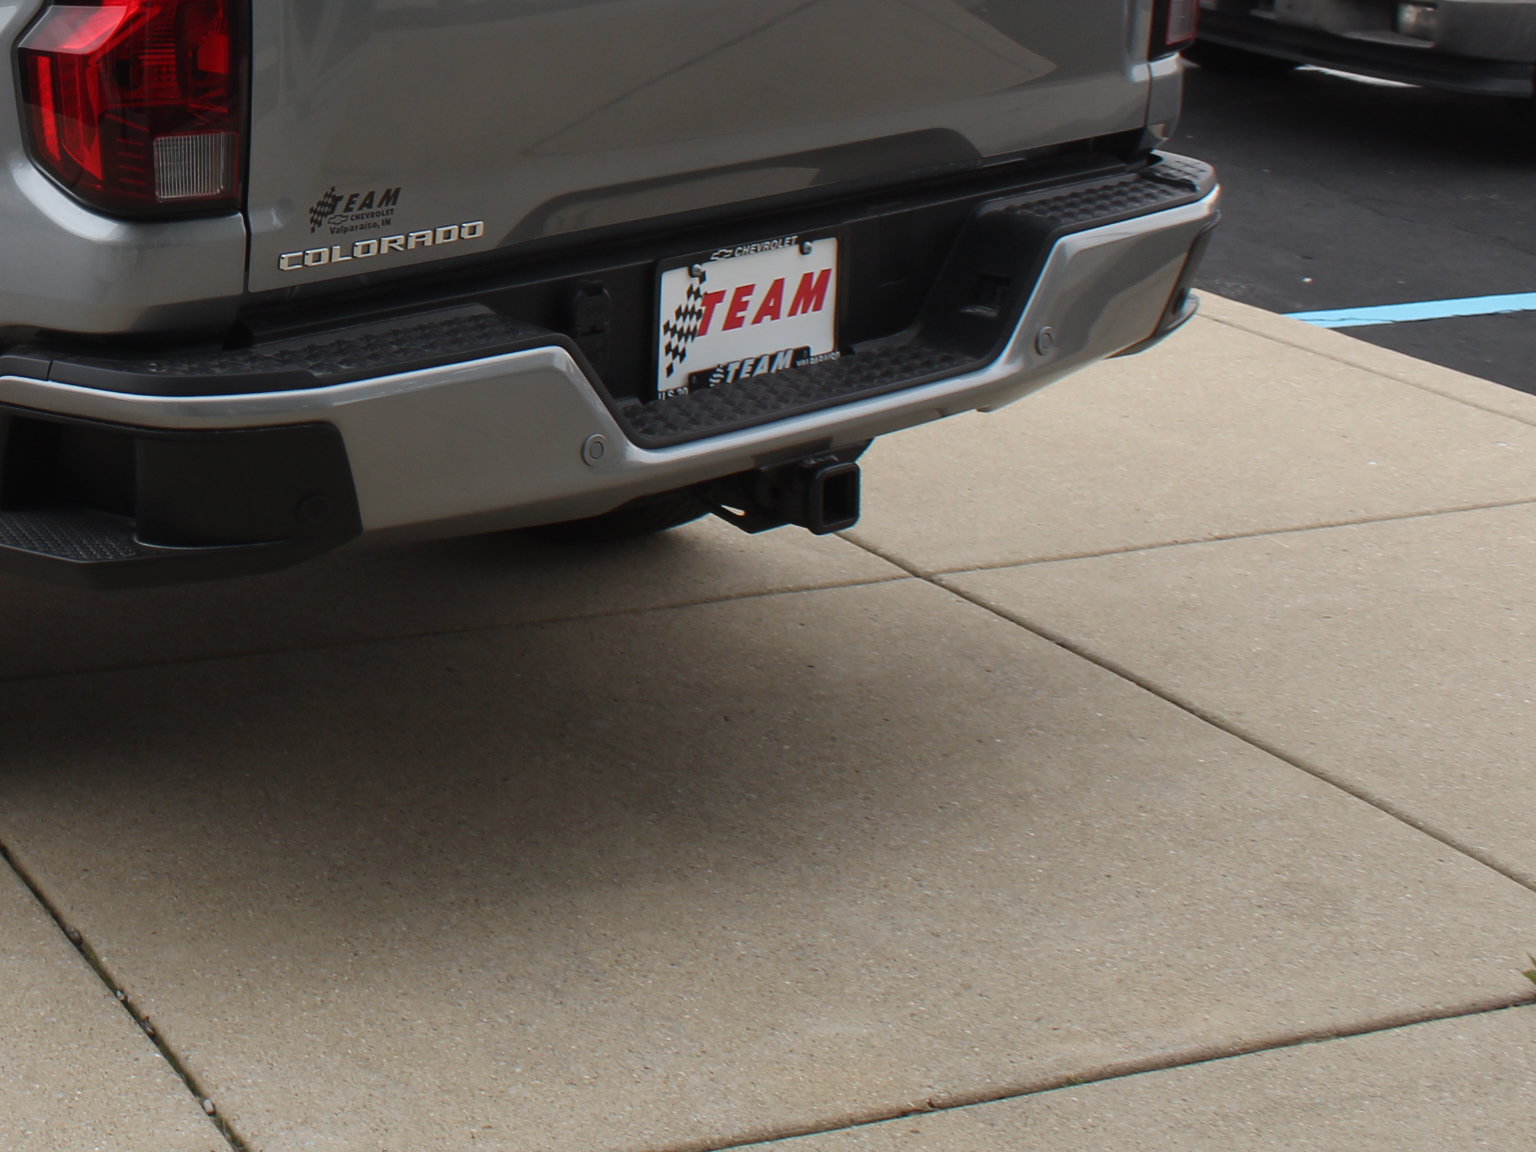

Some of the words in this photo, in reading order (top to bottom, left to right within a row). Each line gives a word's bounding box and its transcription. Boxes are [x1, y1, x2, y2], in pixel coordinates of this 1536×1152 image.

[330, 187, 402, 214] TEAM
[329, 222, 381, 235] Valparaiso,
[381, 218, 392, 227] IN
[350, 208, 395, 222] CHEVROLET
[279, 220, 485, 271] COLORADO
[733, 235, 799, 258] CHEVROLET
[696, 268, 833, 338] TEAM
[725, 348, 795, 384] TEAM
